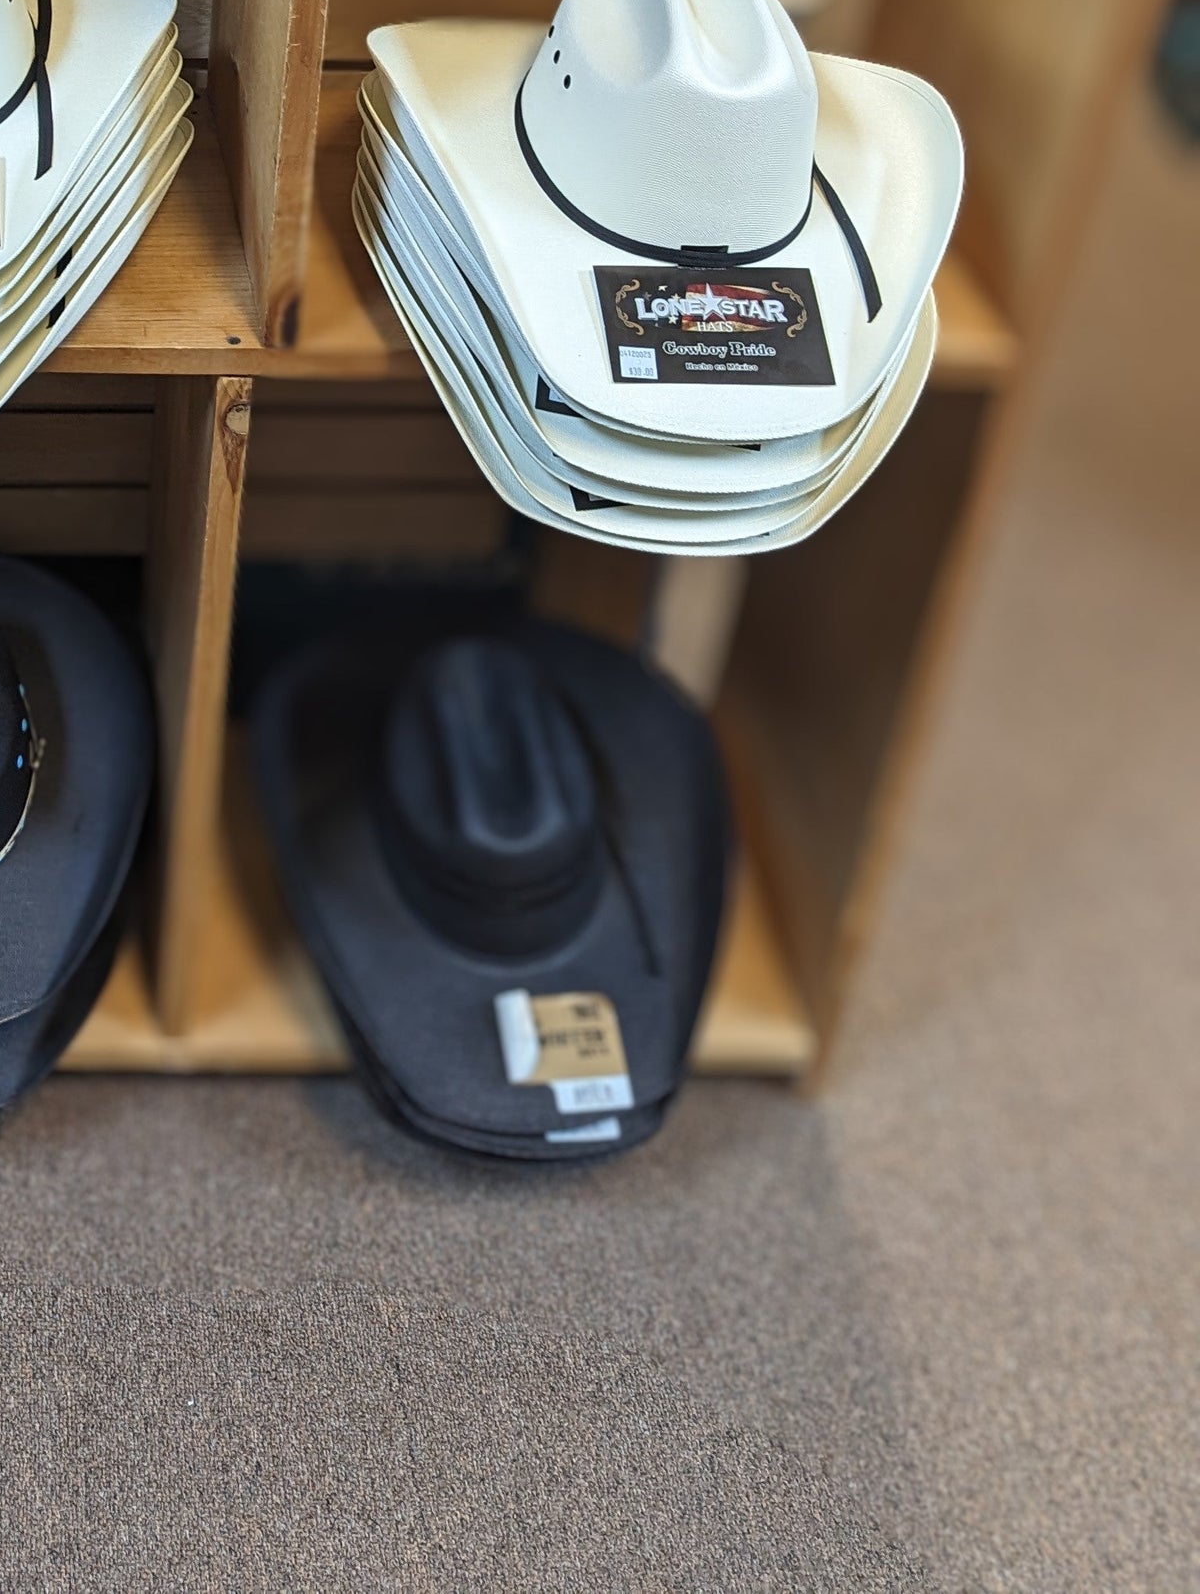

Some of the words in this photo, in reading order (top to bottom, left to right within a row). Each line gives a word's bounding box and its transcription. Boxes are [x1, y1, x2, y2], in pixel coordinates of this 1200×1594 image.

[634, 297, 699, 321] LONE
[723, 298, 788, 323] STAR
[696, 320, 735, 332] HATS
[662, 341, 727, 358] Cowboy
[730, 342, 777, 357] Pride
[685, 362, 713, 371] Hecho
[714, 363, 726, 371] en
